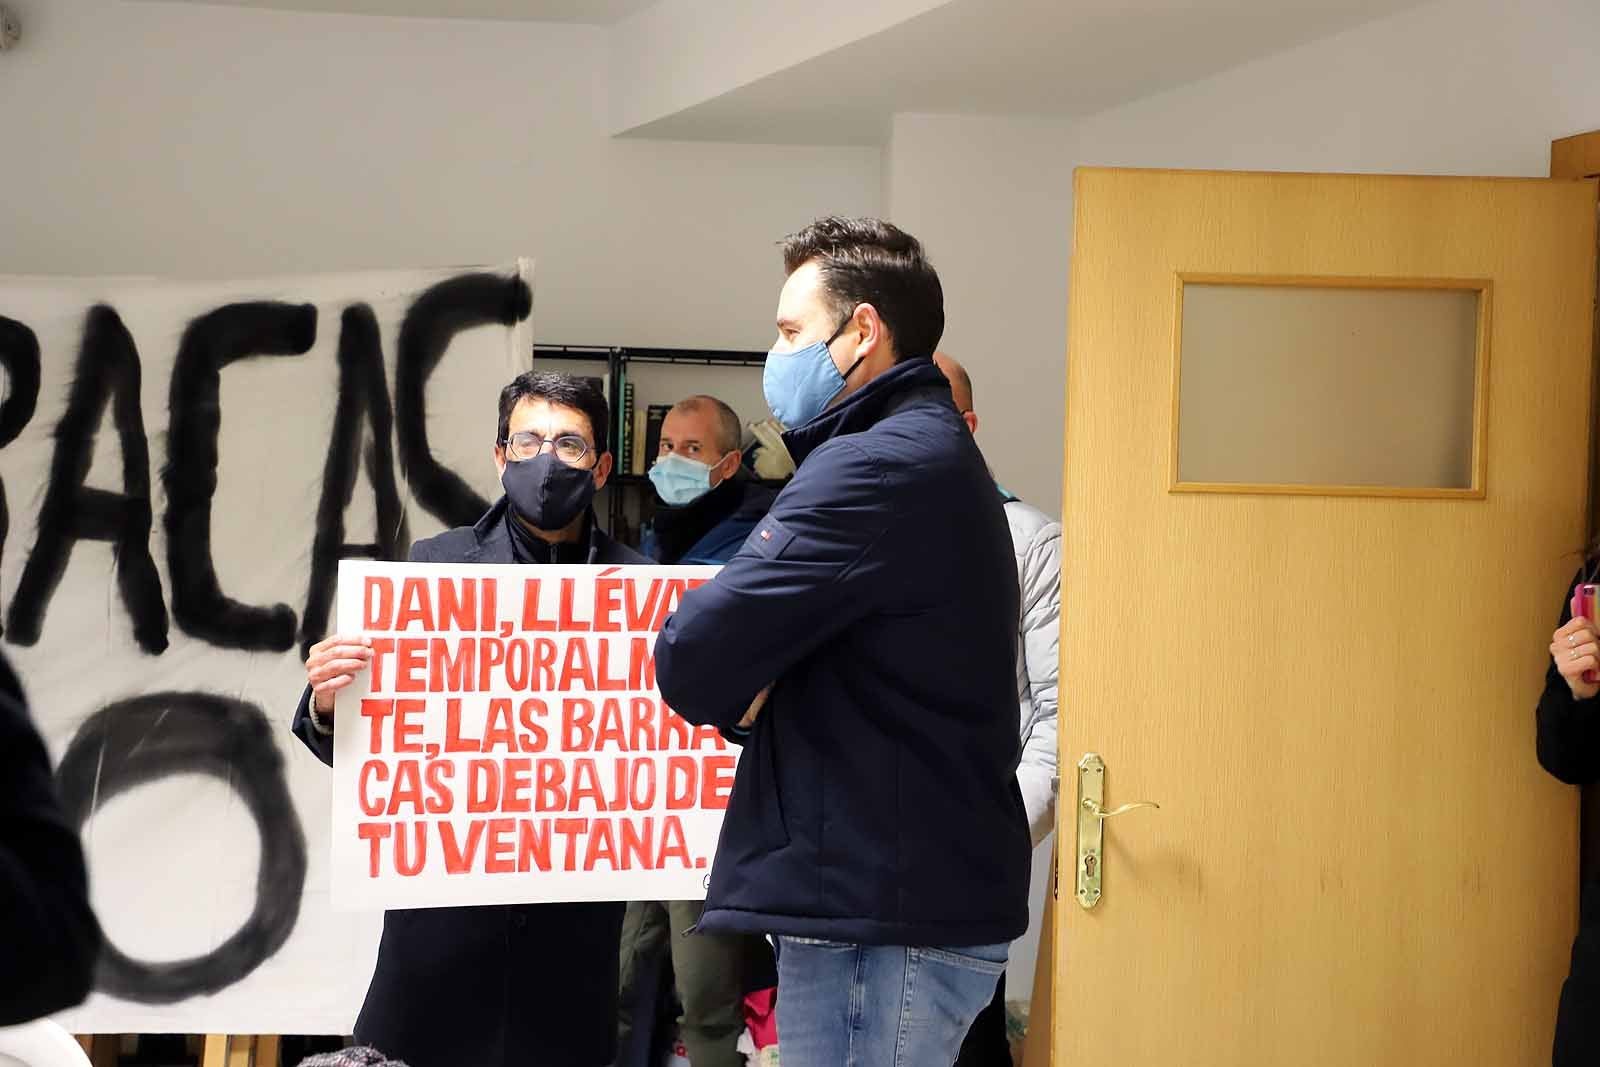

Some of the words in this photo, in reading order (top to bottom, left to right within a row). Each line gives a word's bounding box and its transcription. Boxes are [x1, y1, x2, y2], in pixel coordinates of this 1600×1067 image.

[362, 575, 515, 639] DANI,
[521, 566, 710, 633] LLÉVA
[360, 697, 441, 760] TE,
[443, 697, 549, 754] LAS
[358, 758, 455, 817] CAS
[466, 756, 657, 814] DEBAJO
[665, 754, 737, 811] DE
[357, 820, 428, 879] TU
[437, 814, 708, 876] VENTANA.
